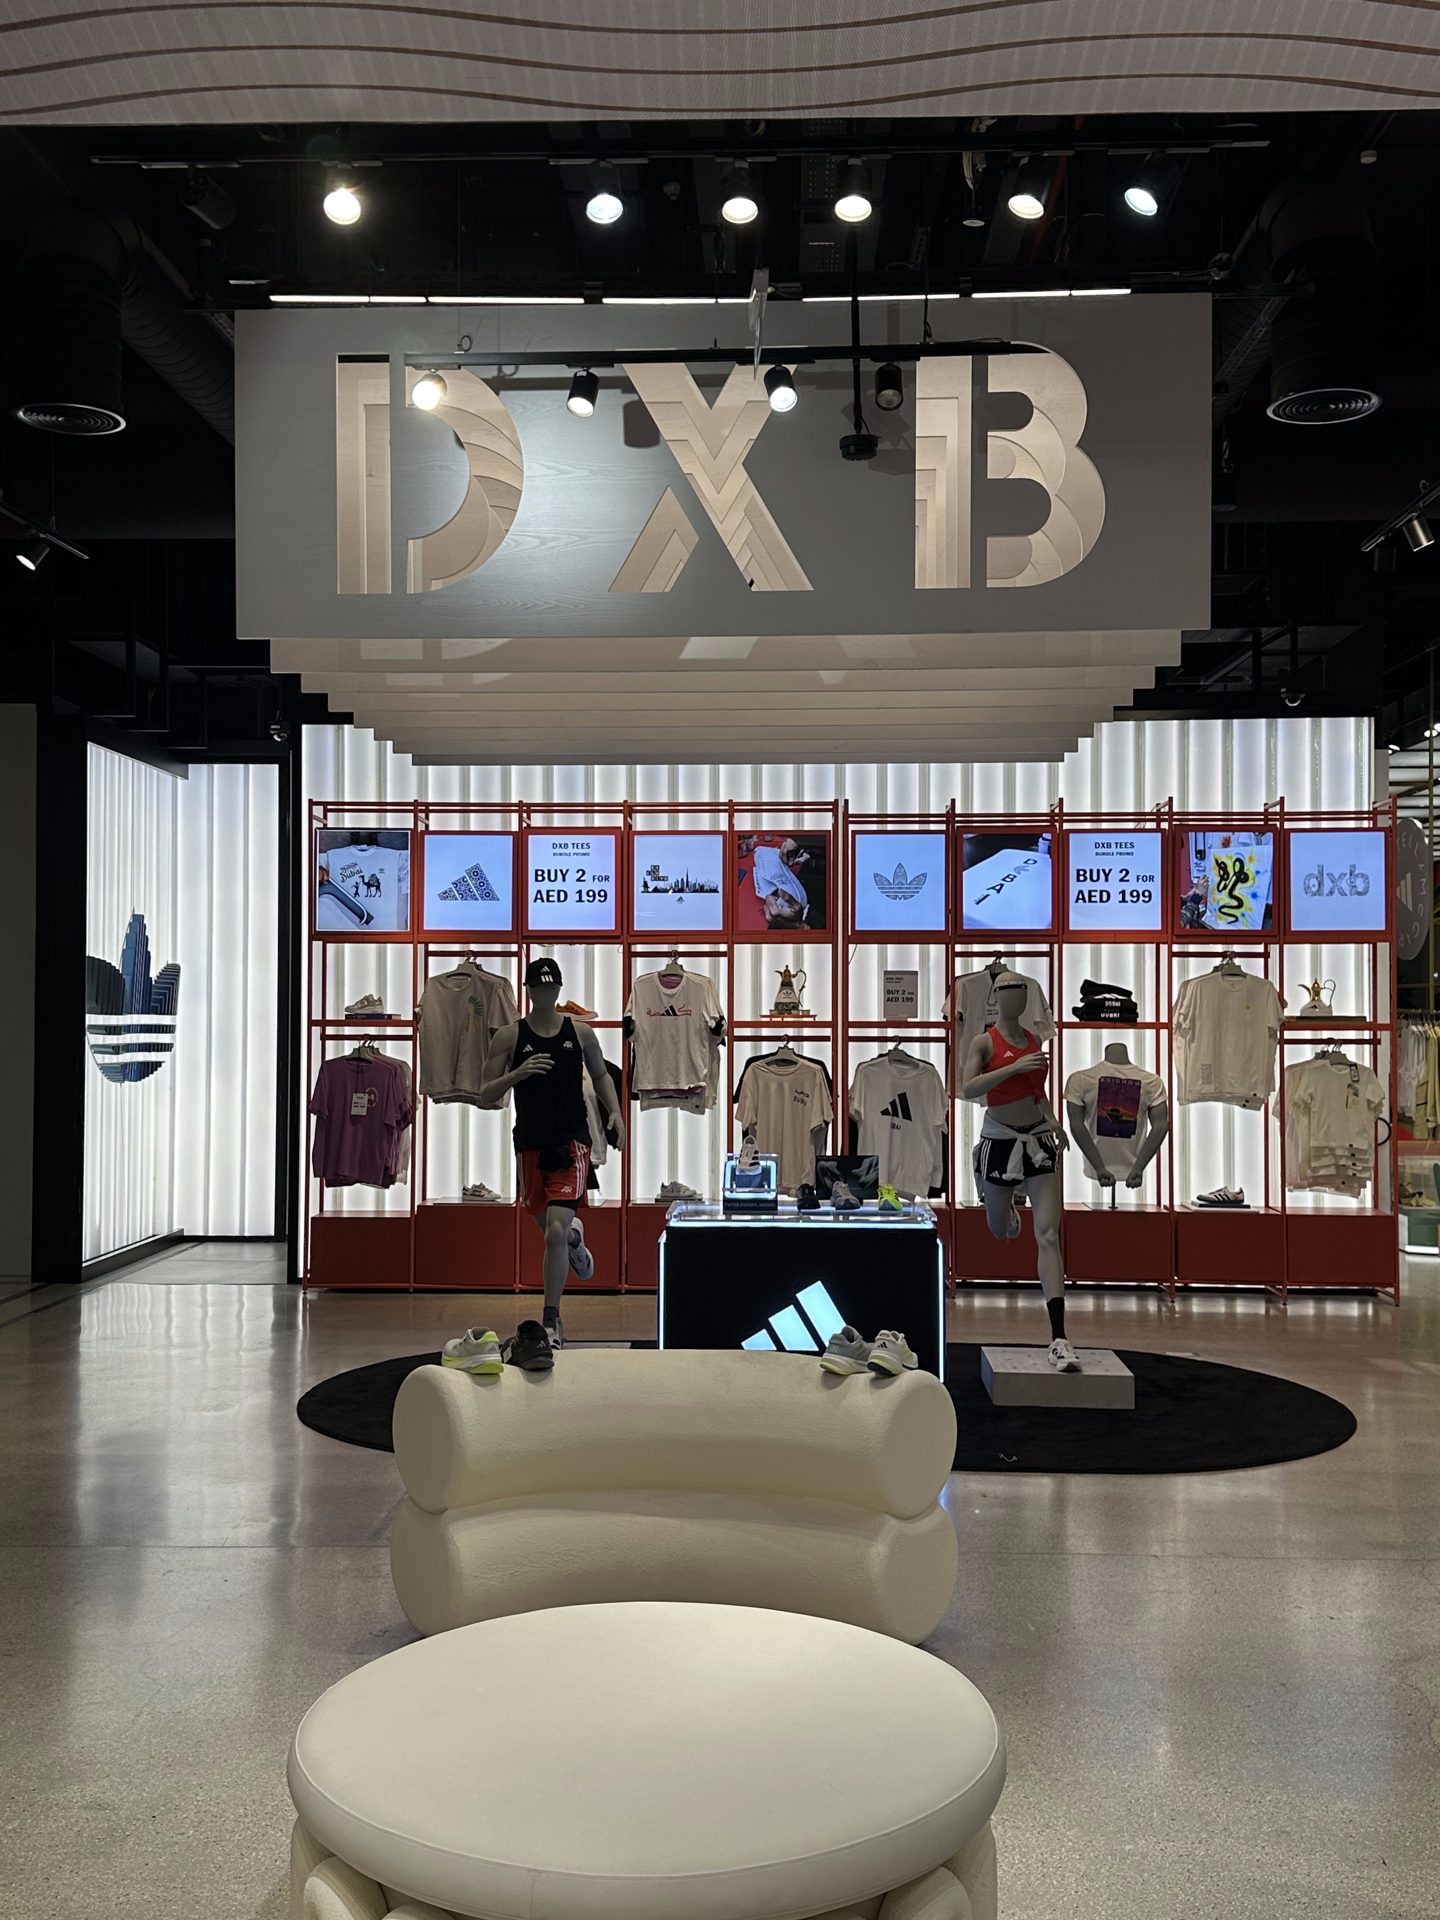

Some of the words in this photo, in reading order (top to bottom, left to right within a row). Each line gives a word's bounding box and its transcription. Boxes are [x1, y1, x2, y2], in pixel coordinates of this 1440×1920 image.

[336, 342, 1106, 594] DXB
[534, 868, 570, 883] BUY
[575, 868, 586, 883] 2
[592, 874, 610, 883] FOR
[1076, 868, 1113, 883] BUY
[1118, 868, 1130, 883] 2
[1136, 874, 1155, 882] FOR
[1303, 864, 1370, 897] dxb
[533, 889, 569, 903] AED
[575, 889, 608, 903] 199
[1074, 889, 1111, 904] AED
[1118, 889, 1152, 904] 199
